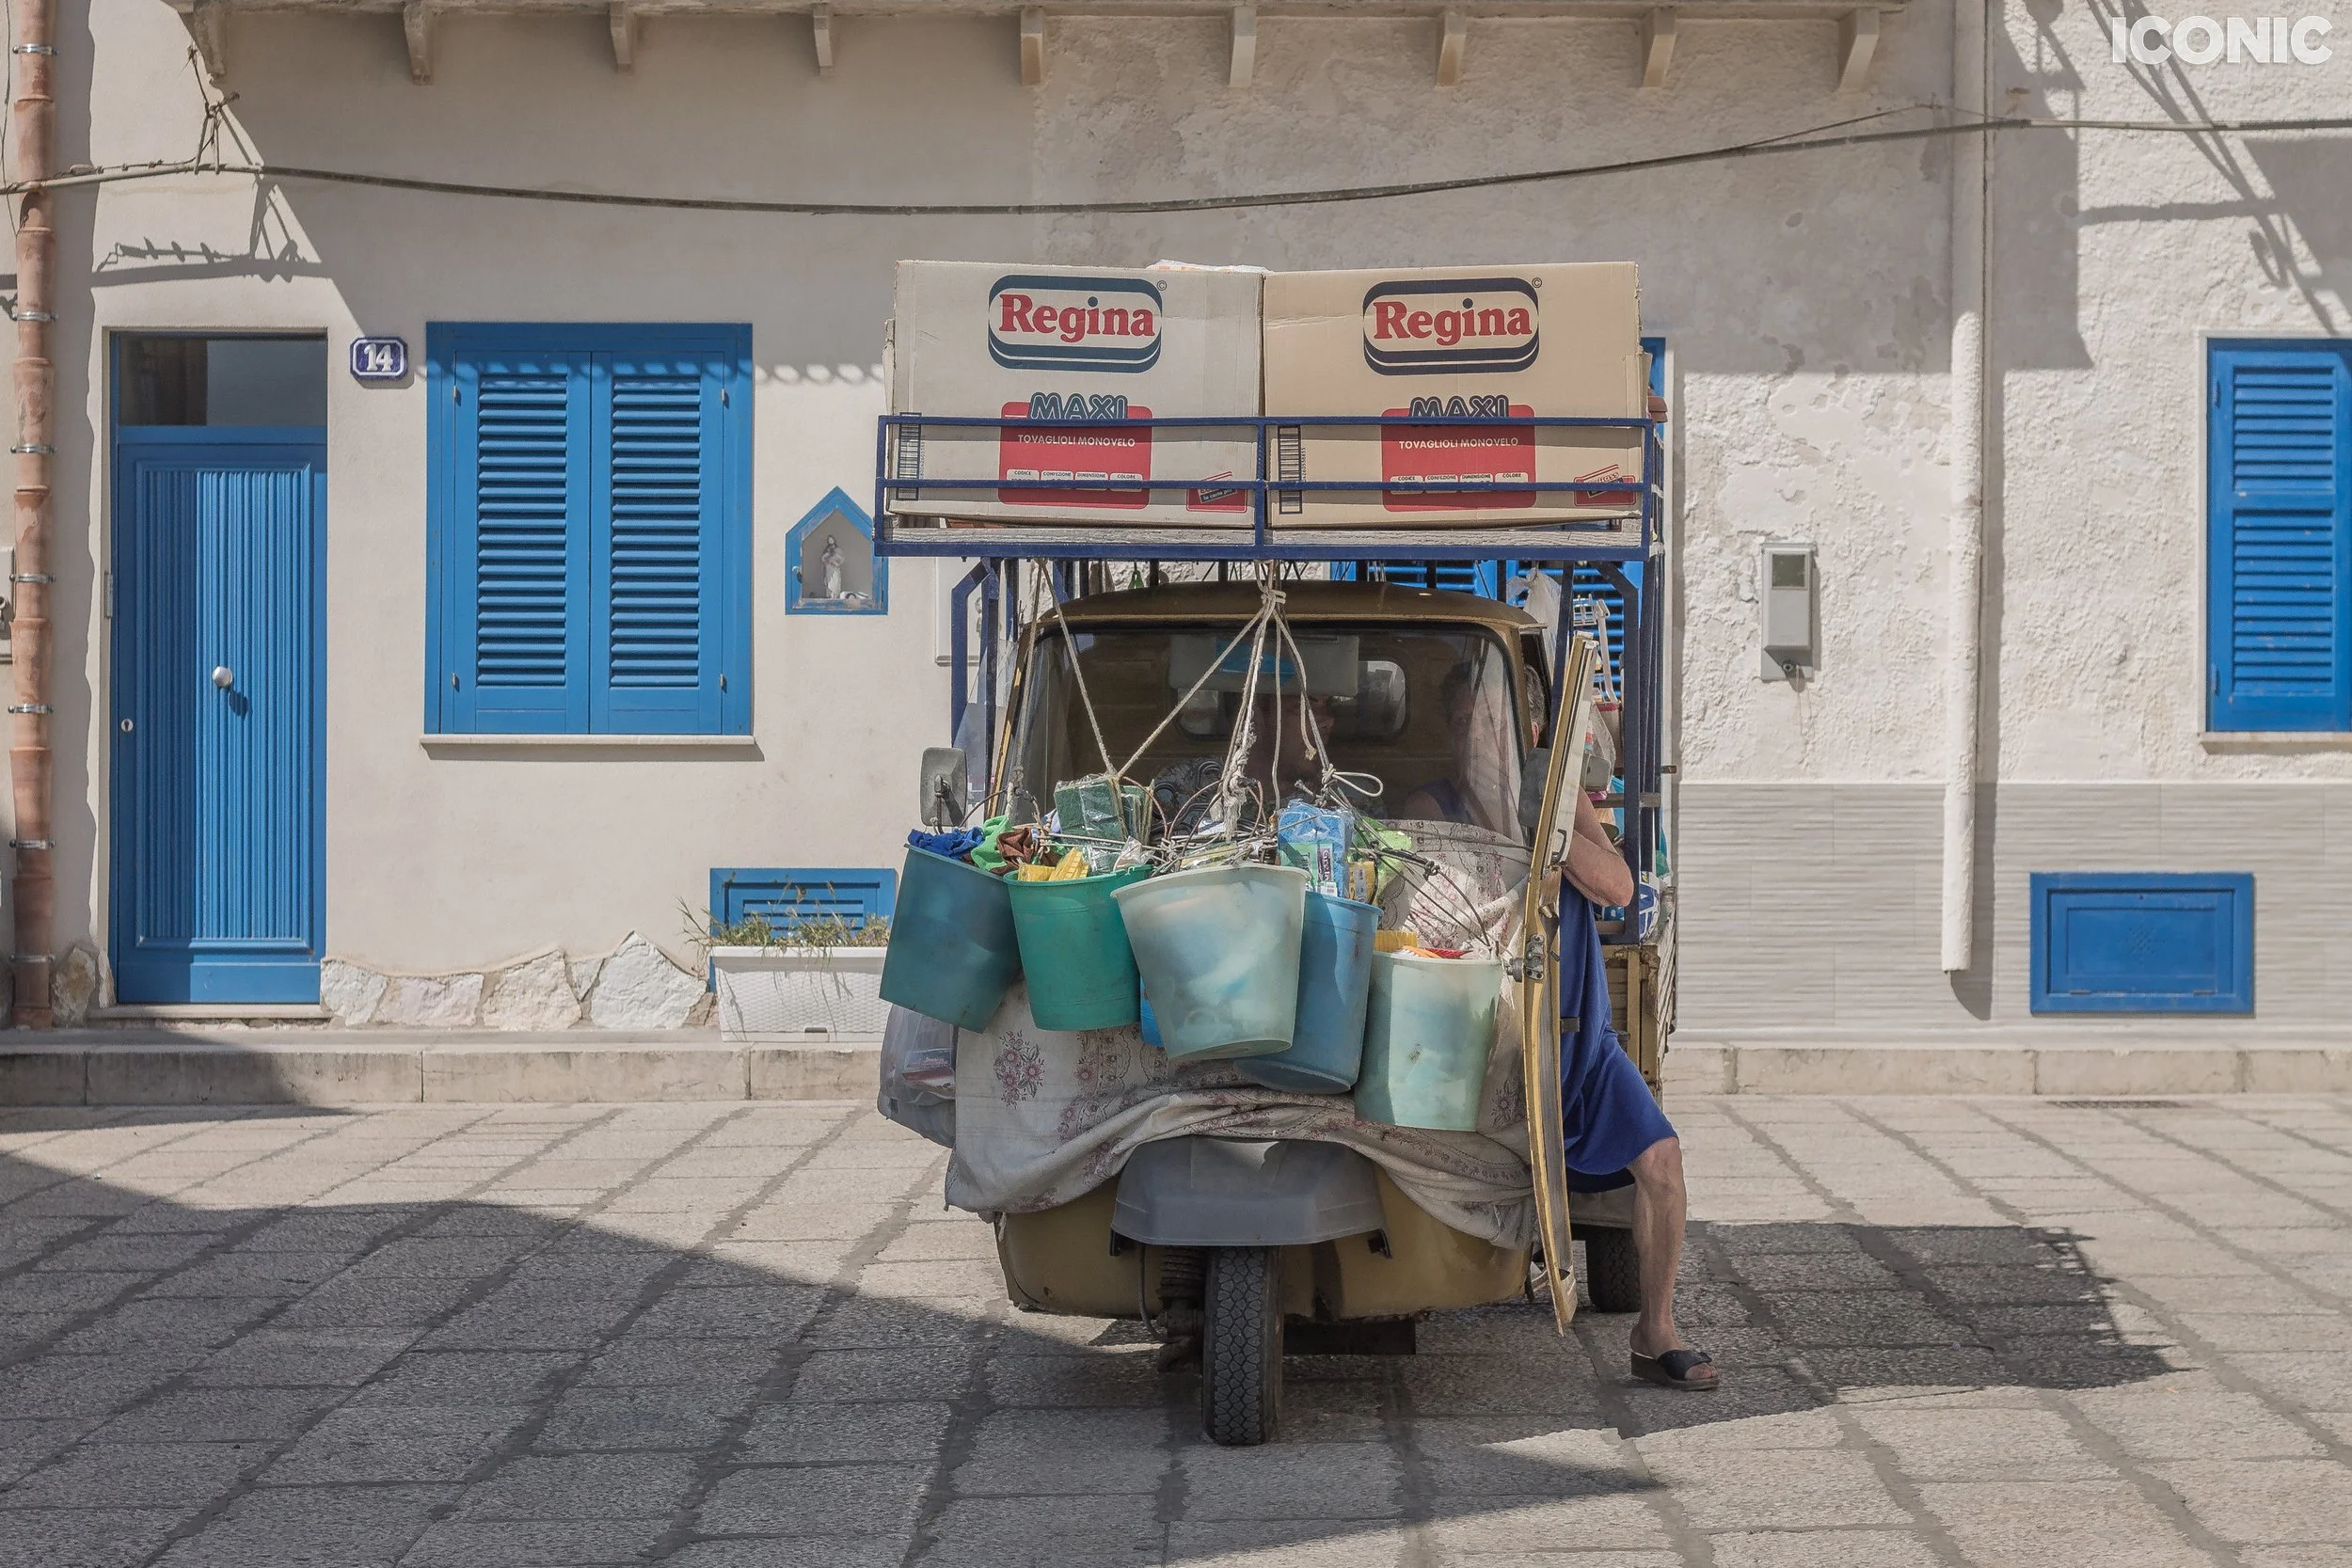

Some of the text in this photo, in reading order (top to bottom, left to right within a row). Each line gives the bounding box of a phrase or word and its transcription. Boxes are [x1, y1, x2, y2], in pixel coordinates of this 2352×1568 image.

[998, 293, 1155, 343] Regina
[1373, 297, 1533, 346] Regina
[363, 342, 393, 372] 14
[1027, 391, 1128, 420] MAXI
[1409, 394, 1509, 418] MAXI
[1017, 435, 1136, 448] TOVAGLIOLI MONOVELO
[1398, 437, 1518, 450] TOVAGLIOLI MONOVELO
